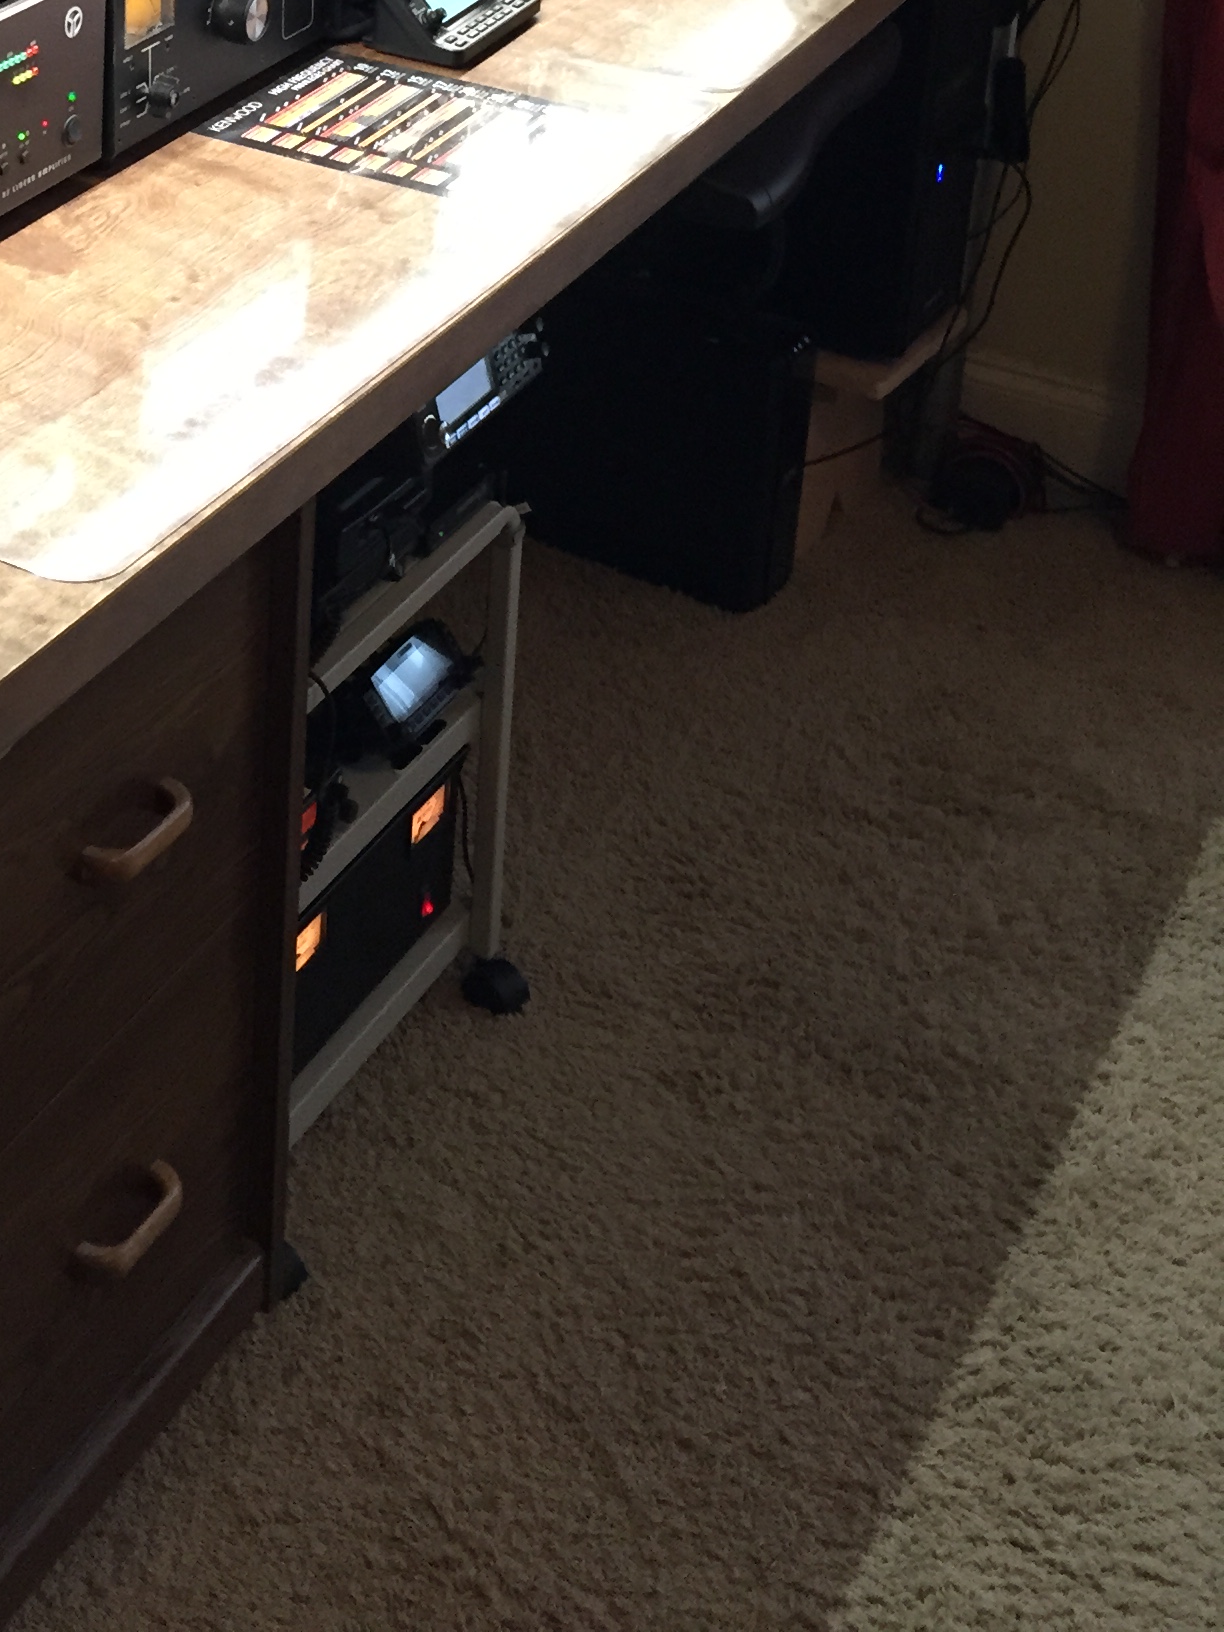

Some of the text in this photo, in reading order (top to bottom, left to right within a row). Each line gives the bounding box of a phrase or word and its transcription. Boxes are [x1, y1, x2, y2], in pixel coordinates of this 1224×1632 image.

[267, 56, 335, 96] HIGH FREQUENCY
[207, 101, 263, 133] KENWOOD
